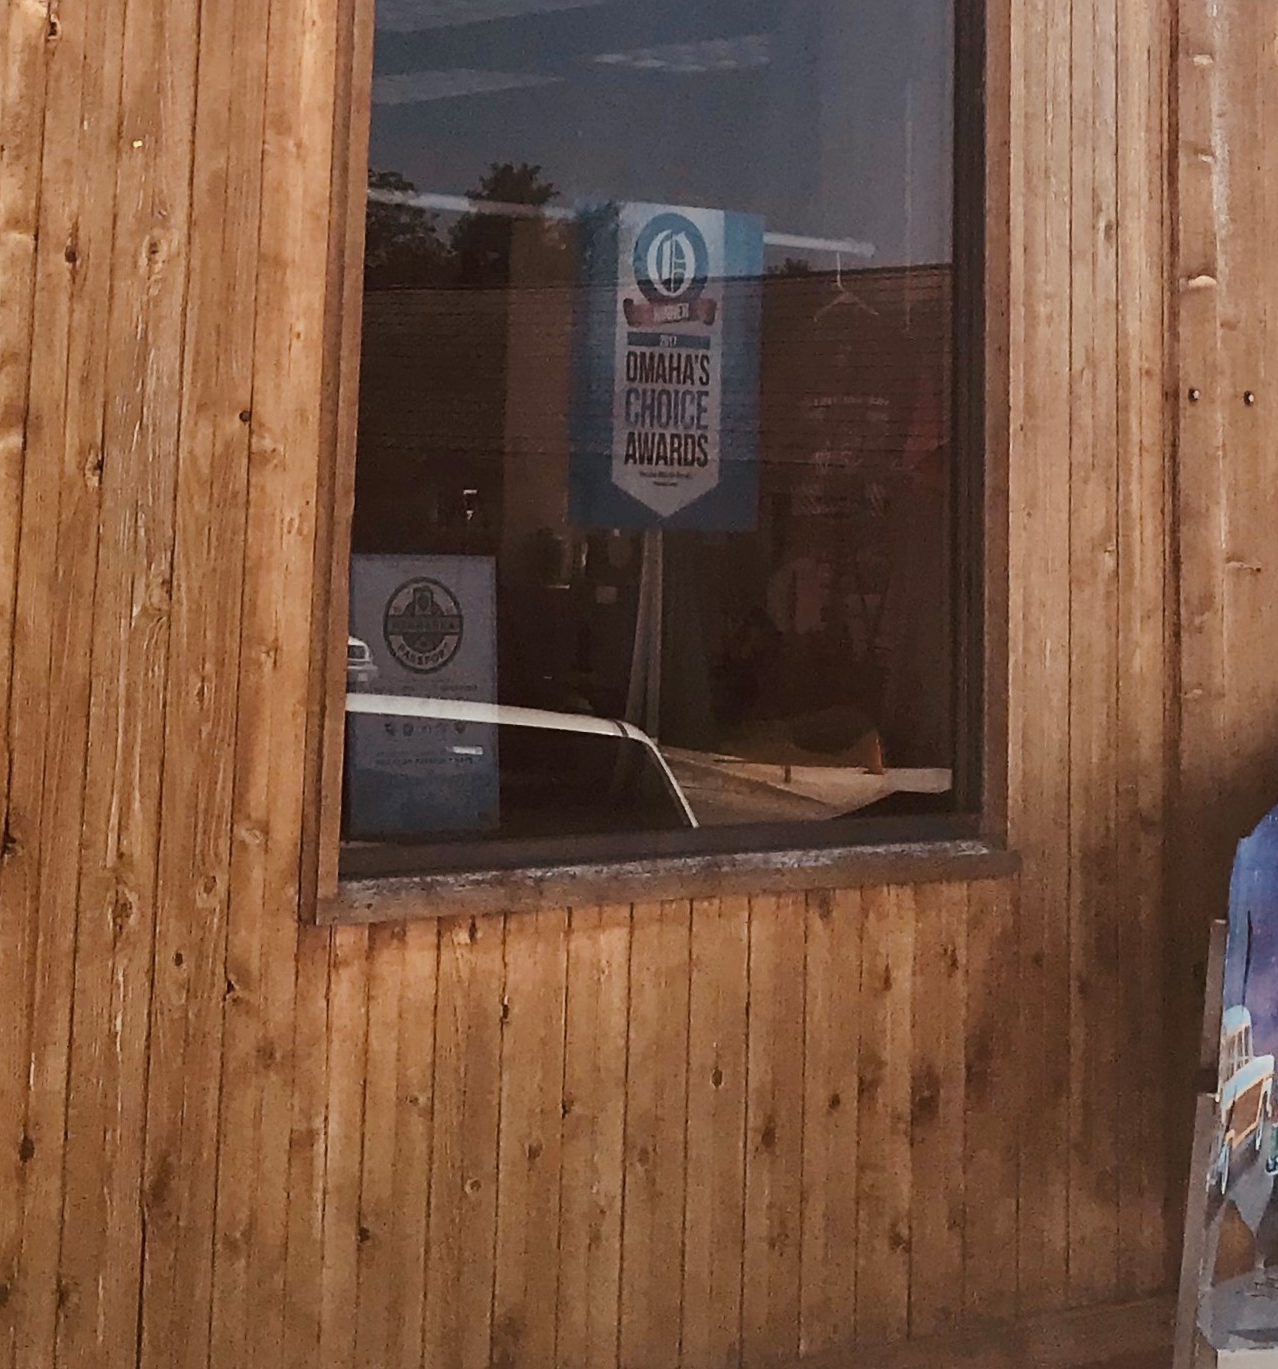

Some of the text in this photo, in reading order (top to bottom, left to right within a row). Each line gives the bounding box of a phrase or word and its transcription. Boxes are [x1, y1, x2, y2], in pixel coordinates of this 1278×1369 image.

[626, 351, 710, 386] OMAHA'S
[624, 387, 709, 430] CHOICE
[624, 432, 709, 467] AWARDS
